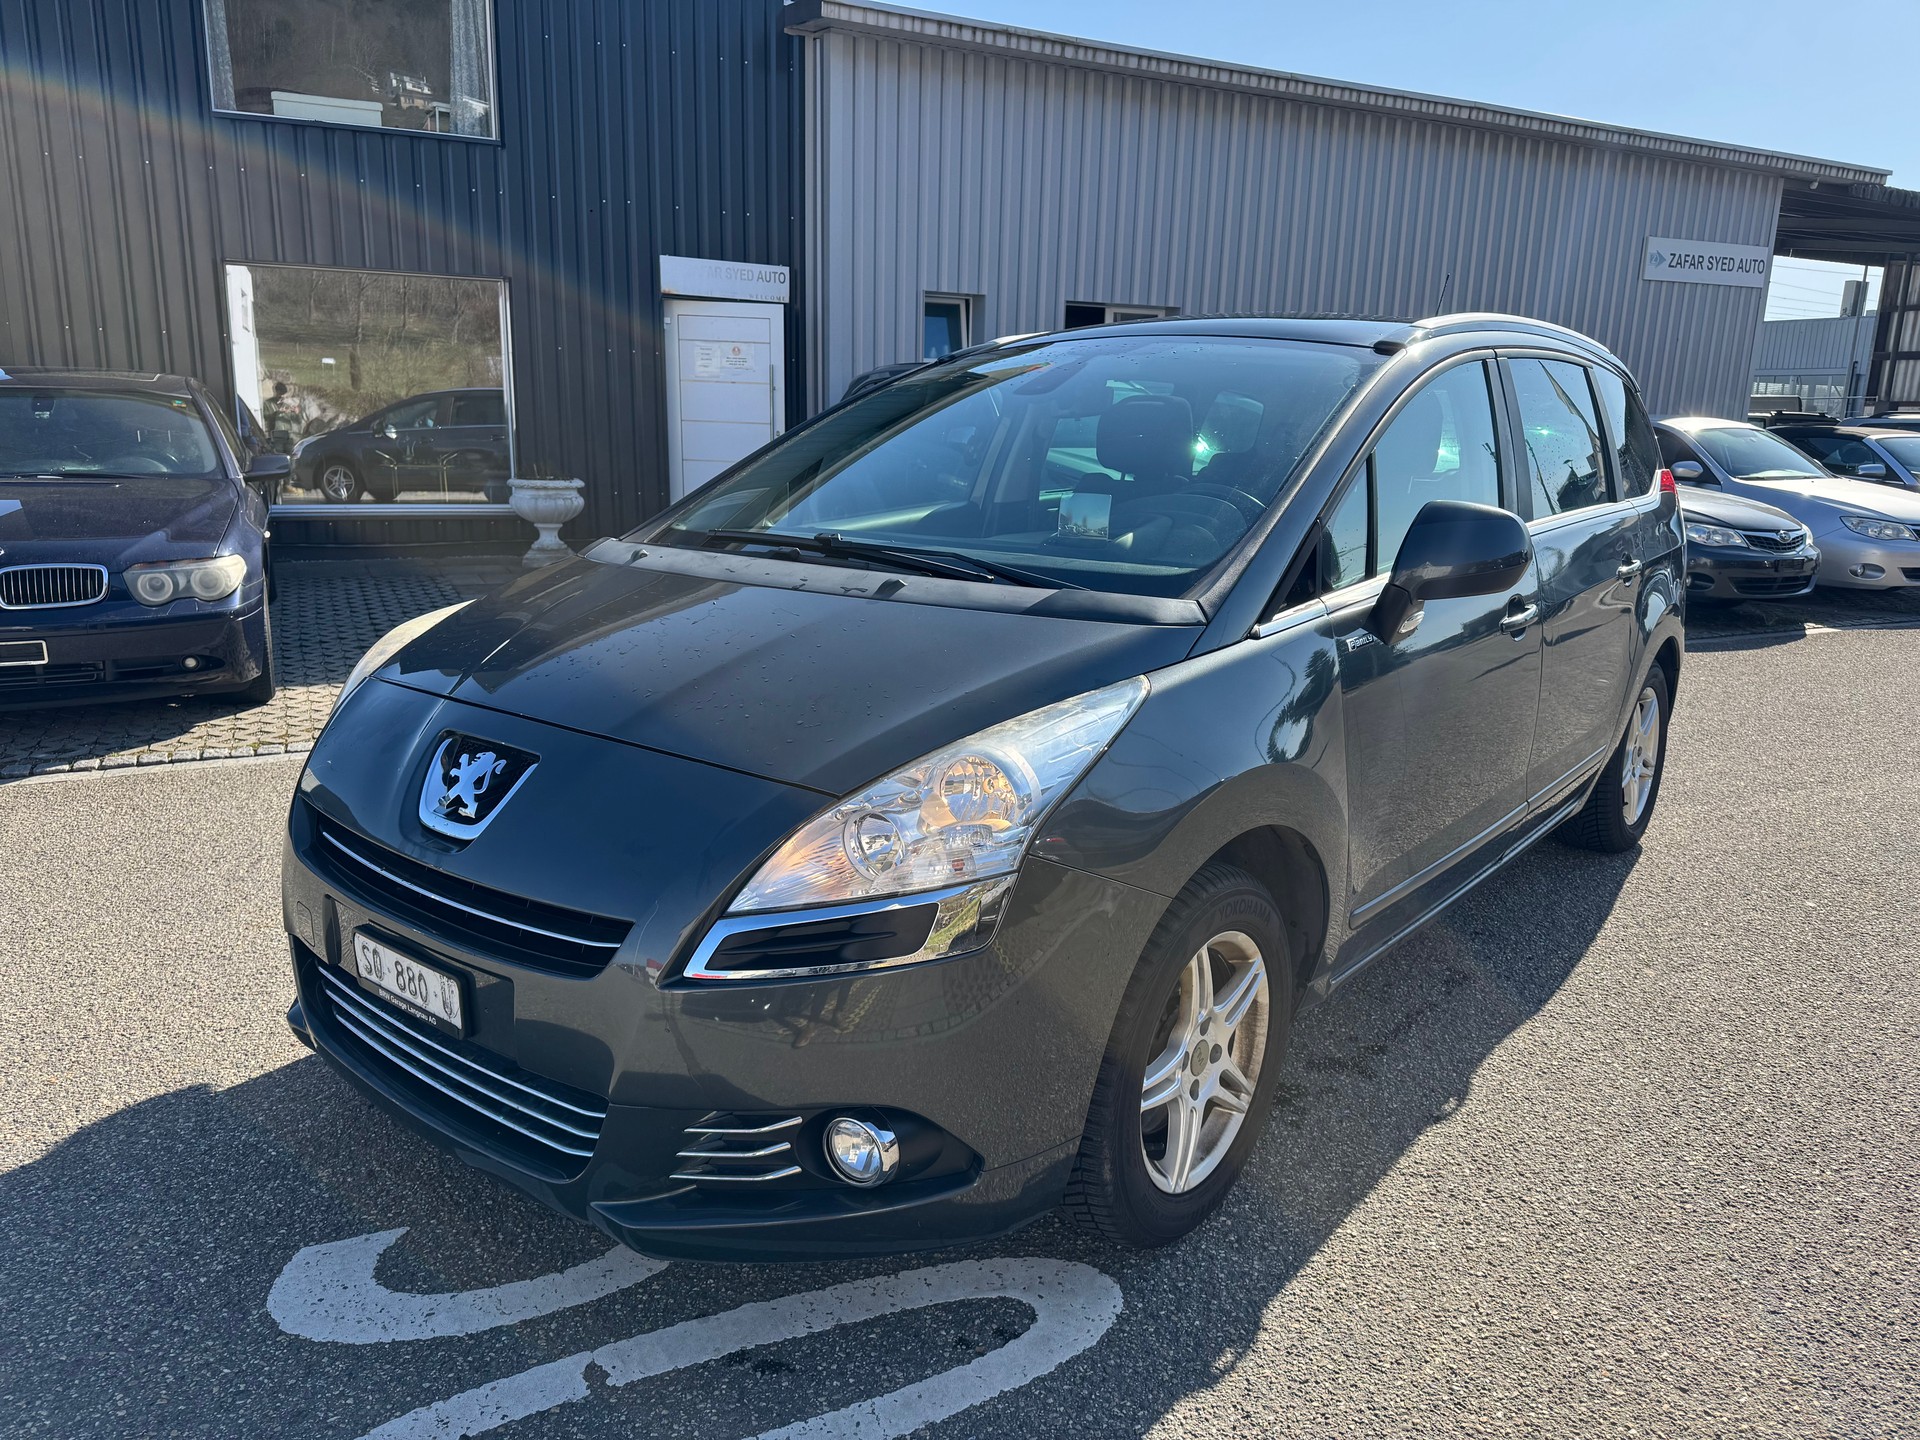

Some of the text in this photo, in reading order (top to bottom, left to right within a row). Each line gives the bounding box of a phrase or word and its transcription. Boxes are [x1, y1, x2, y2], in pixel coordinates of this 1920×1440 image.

[1668, 253, 1766, 274] ZAFAR SYED AUTO
[725, 267, 754, 281] SYED
[756, 271, 786, 284] AUTO
[394, 960, 428, 1003] 880
